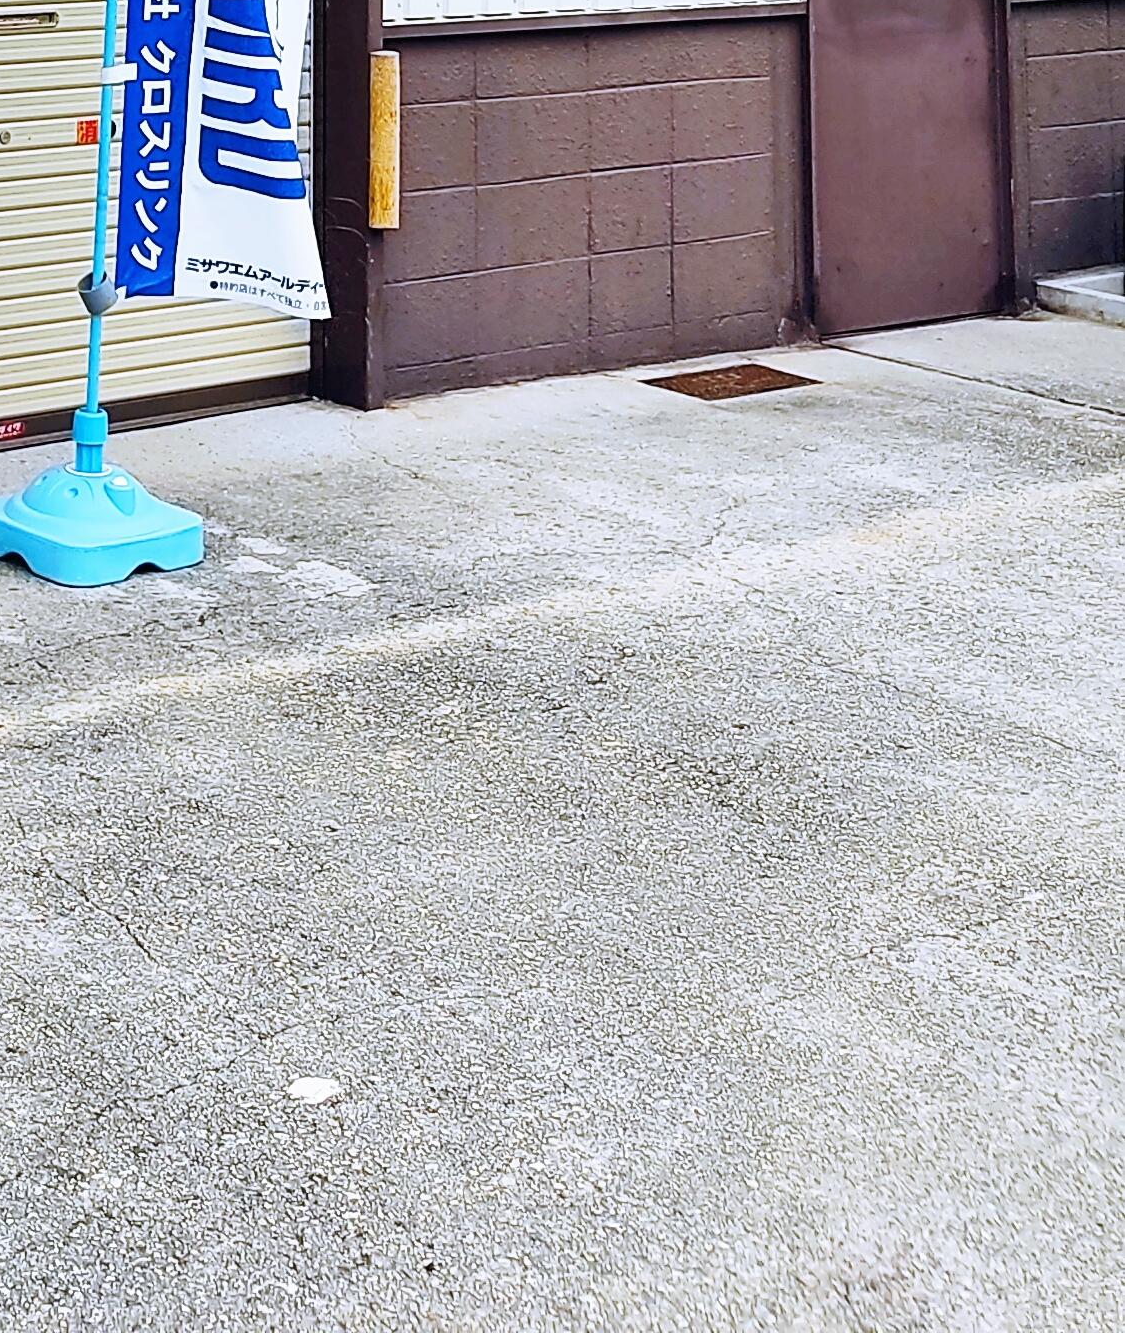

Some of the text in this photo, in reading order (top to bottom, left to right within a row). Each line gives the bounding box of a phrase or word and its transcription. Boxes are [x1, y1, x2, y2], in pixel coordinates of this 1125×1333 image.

[129, 39, 177, 272] クロスリンク
